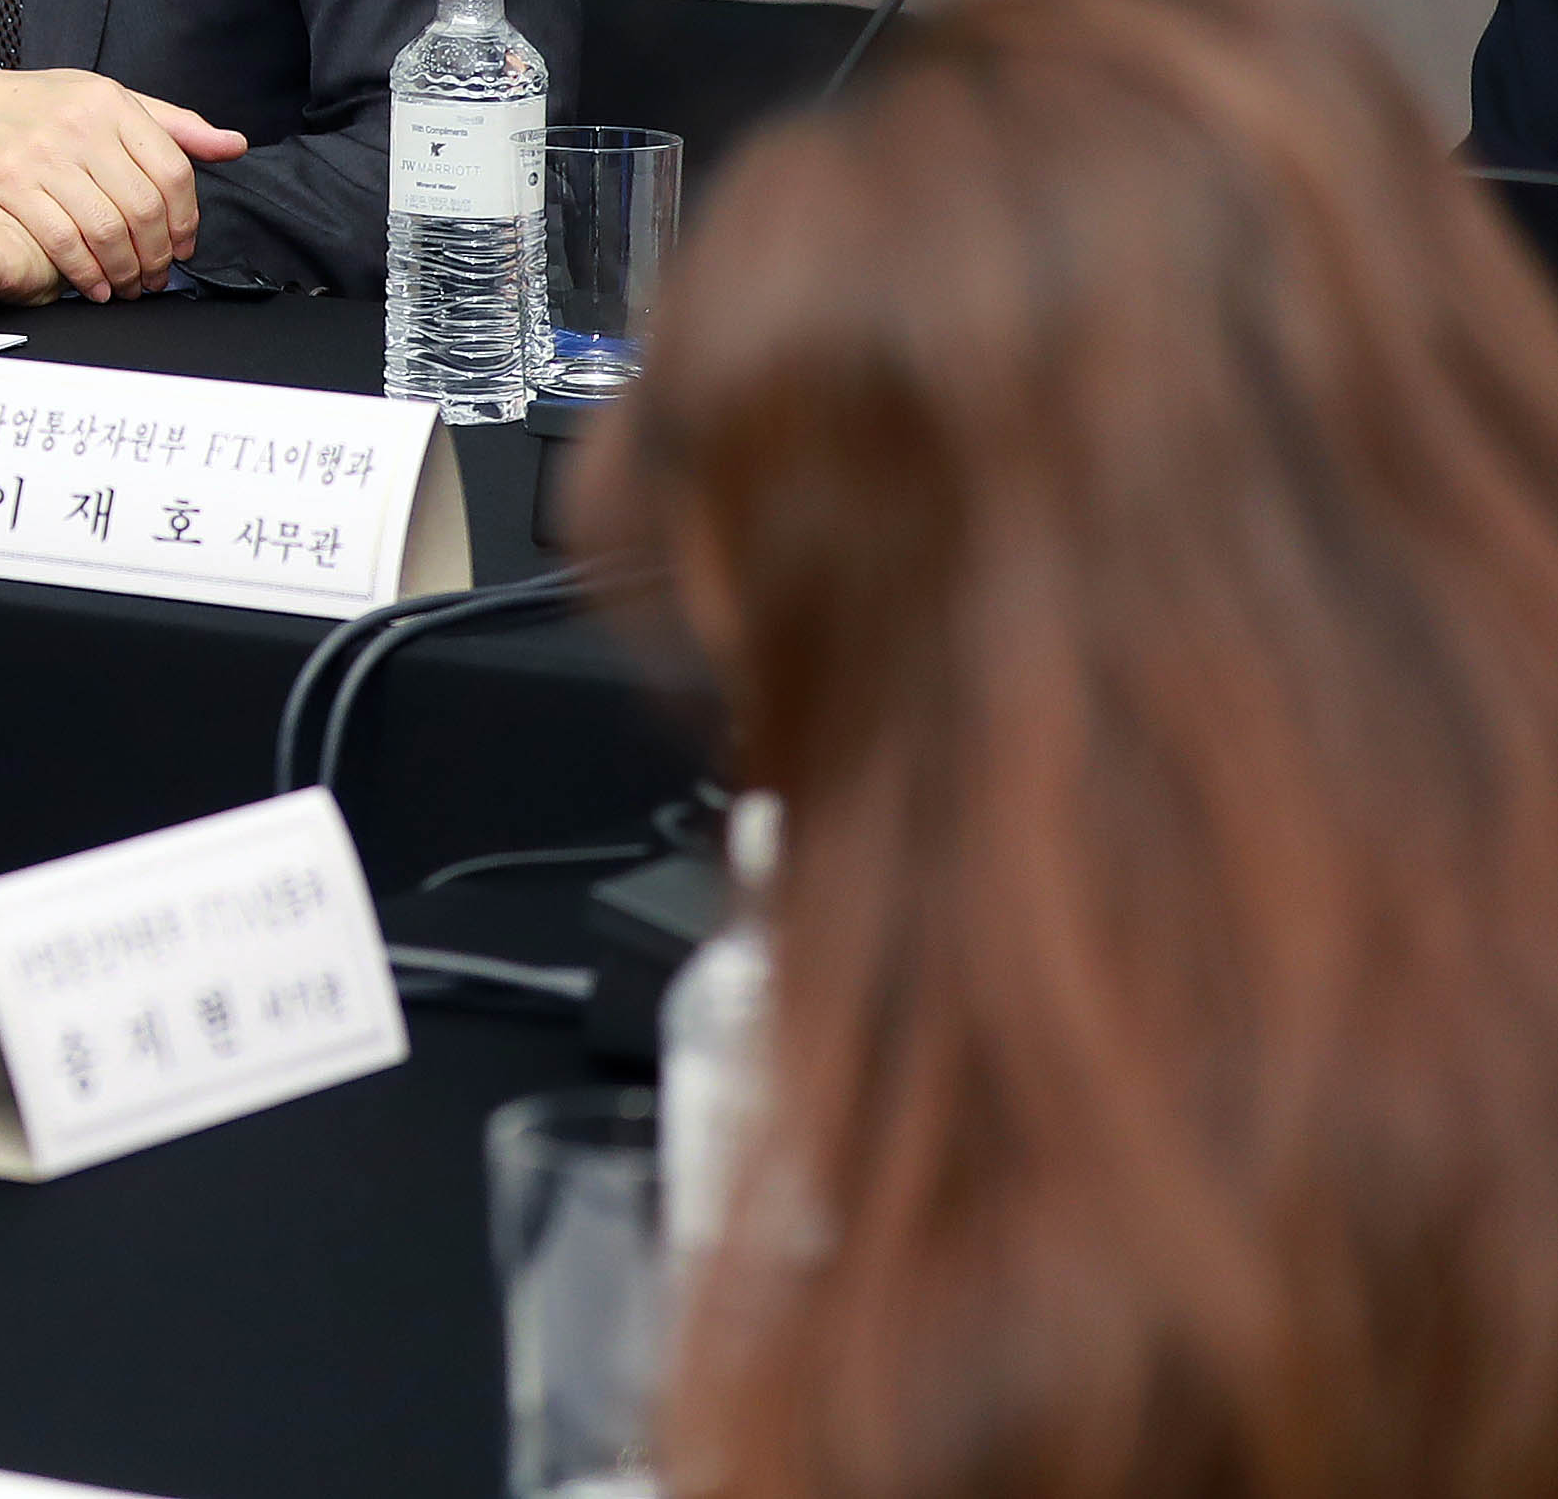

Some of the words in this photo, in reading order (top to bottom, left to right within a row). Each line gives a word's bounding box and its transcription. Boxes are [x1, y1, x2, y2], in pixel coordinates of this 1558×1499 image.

[400, 159, 416, 171] JW
[417, 162, 482, 176] MARRIOTT
[202, 431, 375, 488] FTA이행과
[66, 487, 115, 543] 재
[152, 499, 202, 546] 호
[236, 517, 344, 569] 사무관
